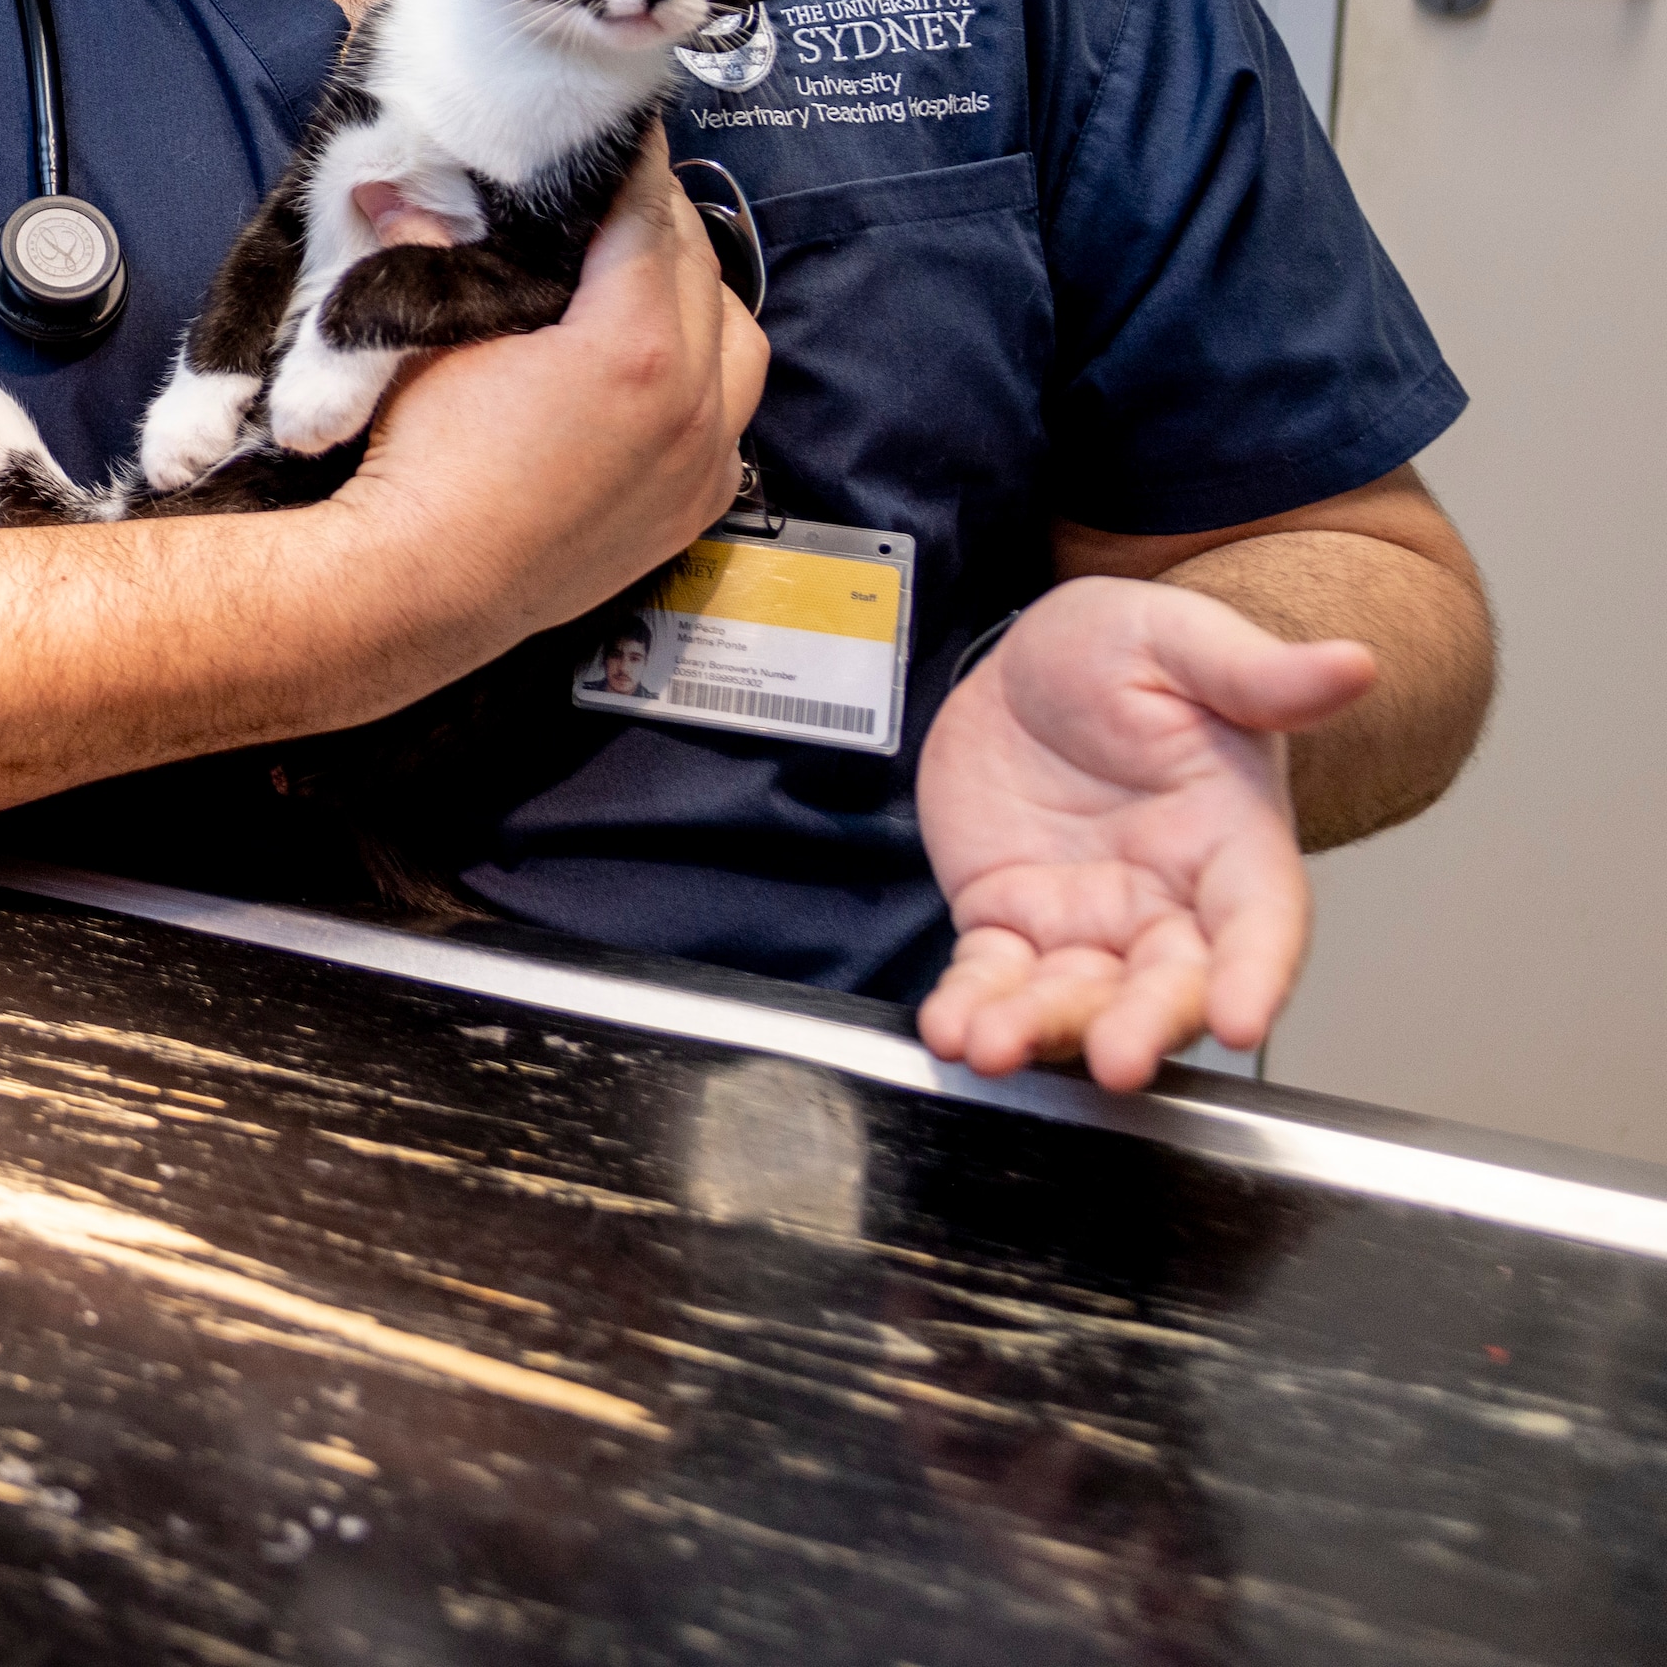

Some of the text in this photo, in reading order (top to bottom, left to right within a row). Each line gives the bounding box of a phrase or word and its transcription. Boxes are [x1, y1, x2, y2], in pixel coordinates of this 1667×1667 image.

[780, 3, 827, 27] THE
[792, 9, 976, 66] SYDNEY
[794, 72, 902, 97] University
[690, 91, 991, 130] Veterinary Teaching Hospitals
[850, 590, 877, 603] Staff
[695, 622, 726, 636] Pedro
[677, 632, 748, 653] Martins Ponte
[674, 655, 798, 681] Library Borrower's Number
